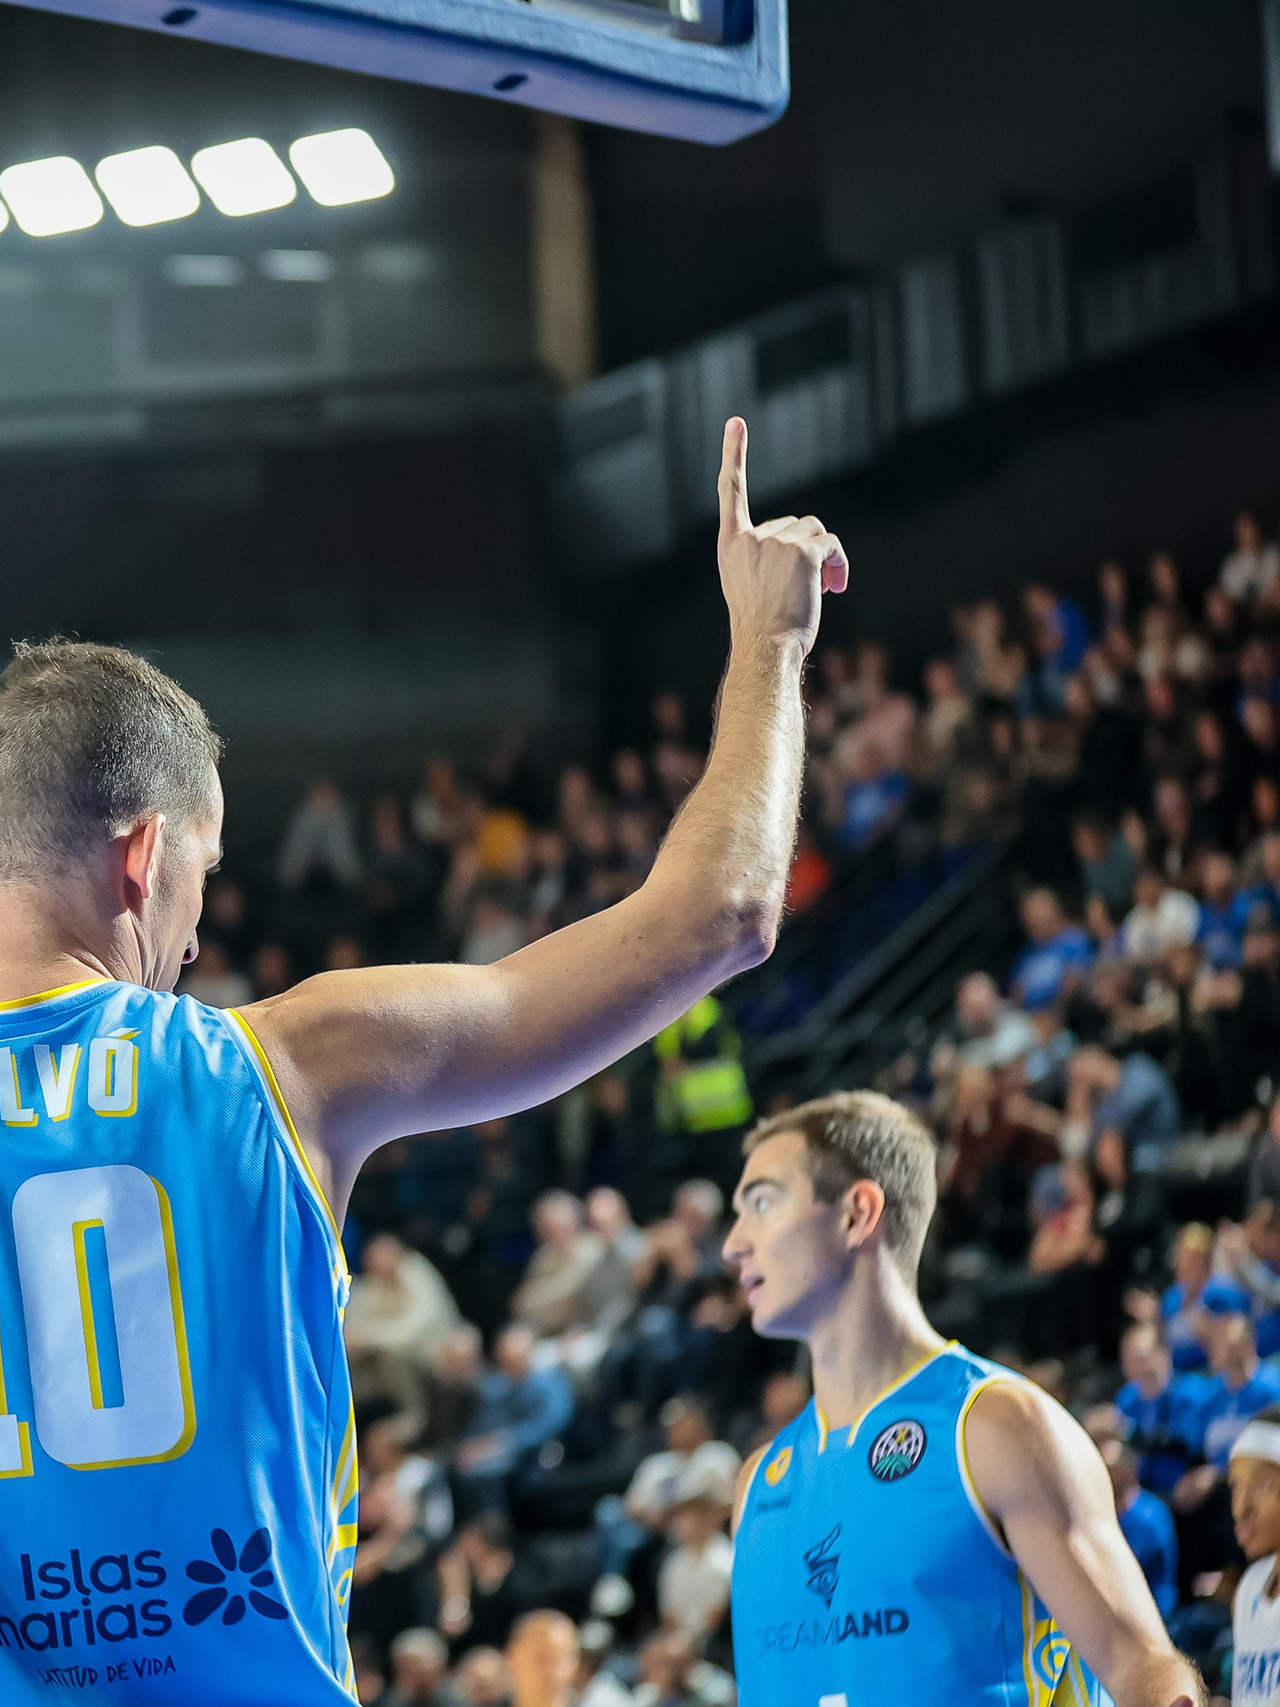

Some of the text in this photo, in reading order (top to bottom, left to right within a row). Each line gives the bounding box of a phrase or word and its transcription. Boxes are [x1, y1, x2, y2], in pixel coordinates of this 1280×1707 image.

[20, 1549, 166, 1600] Islas
[106, 1662, 129, 1683] DE
[132, 1655, 176, 1678] VIDA
